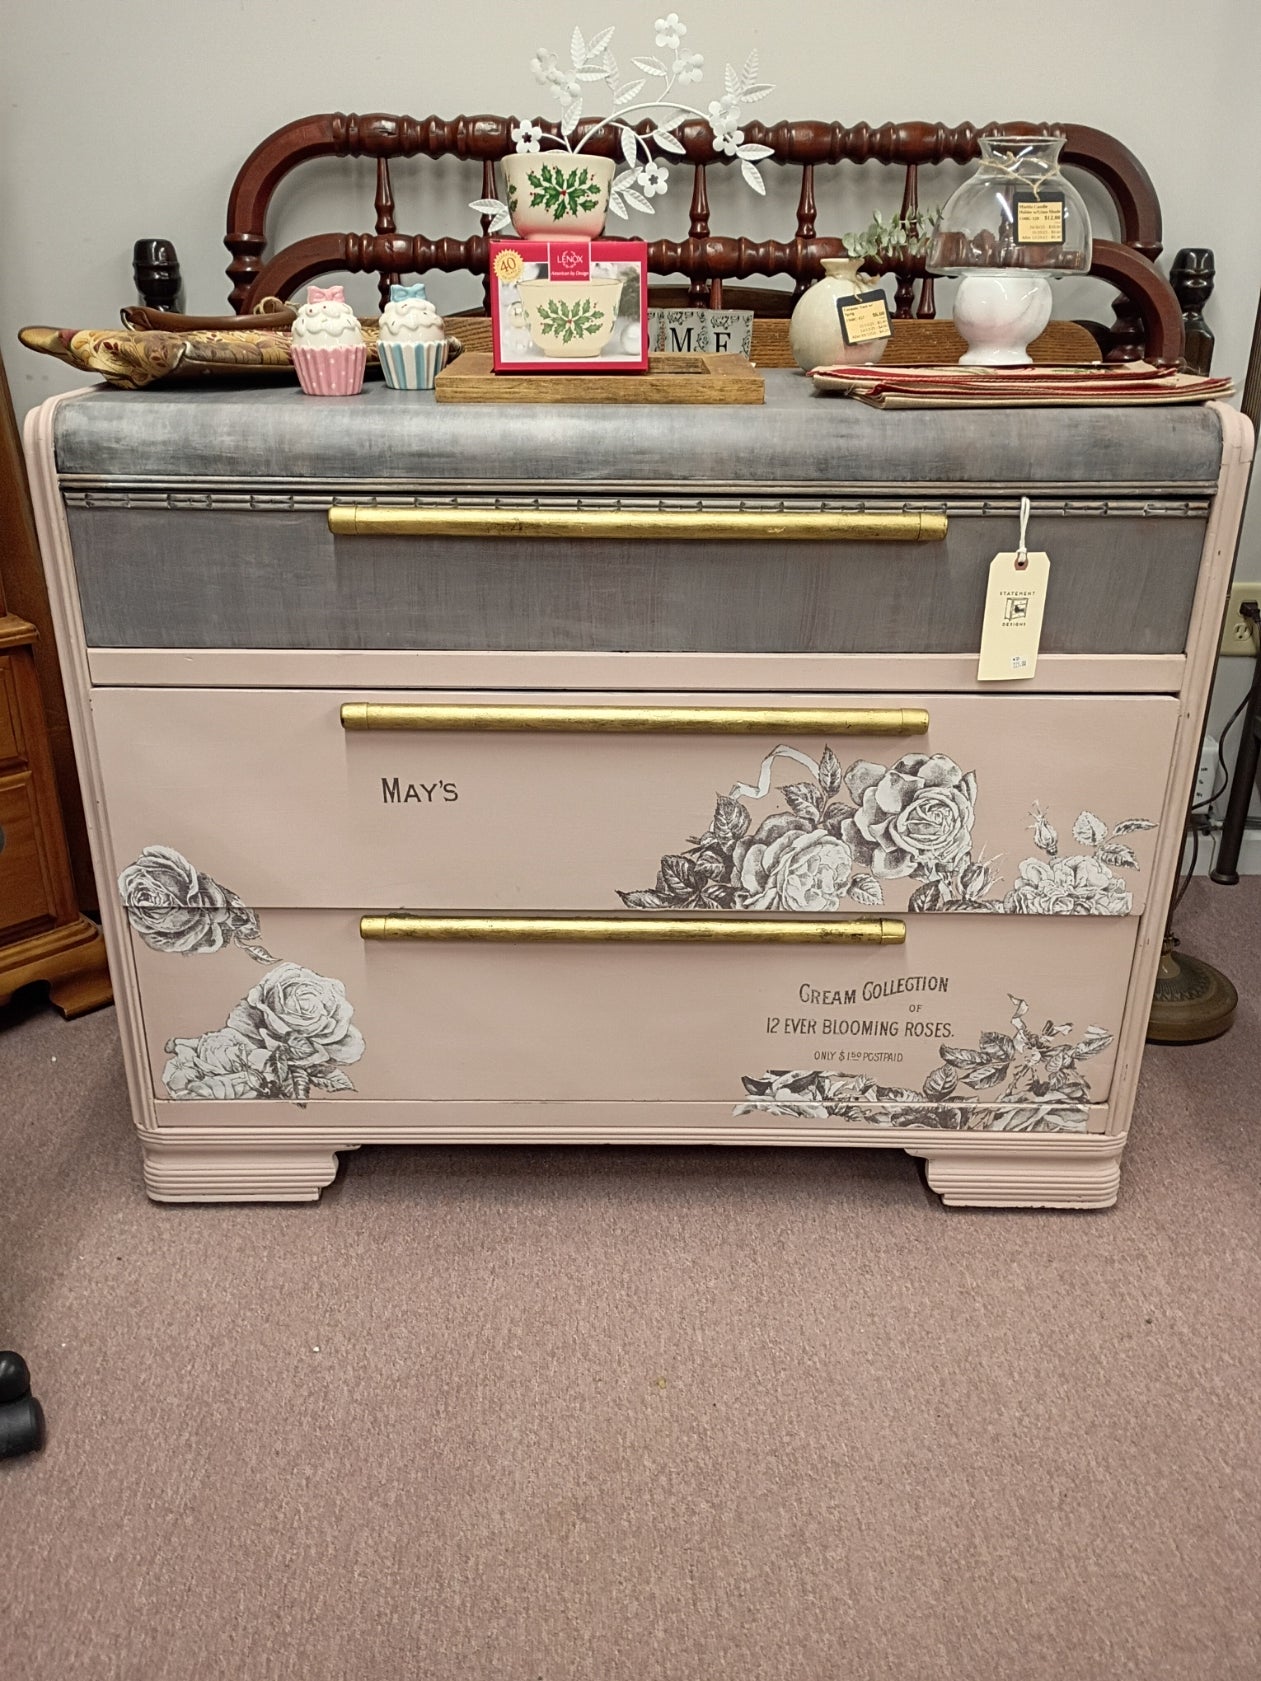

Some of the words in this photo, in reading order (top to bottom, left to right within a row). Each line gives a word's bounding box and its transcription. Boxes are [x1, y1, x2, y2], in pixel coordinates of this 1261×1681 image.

[500, 257, 516, 272] 40
[557, 254, 583, 264] LENOX
[381, 777, 458, 803] MAY'S
[799, 983, 857, 1005] CREAM
[862, 976, 949, 1002] COLLECTION
[909, 1004, 923, 1013] OF
[766, 1017, 780, 1033] 12
[784, 1018, 816, 1034] EVER
[822, 1019, 899, 1036] BLOOMING
[904, 1021, 954, 1038] ROSES.
[814, 1051, 836, 1061] ONLY
